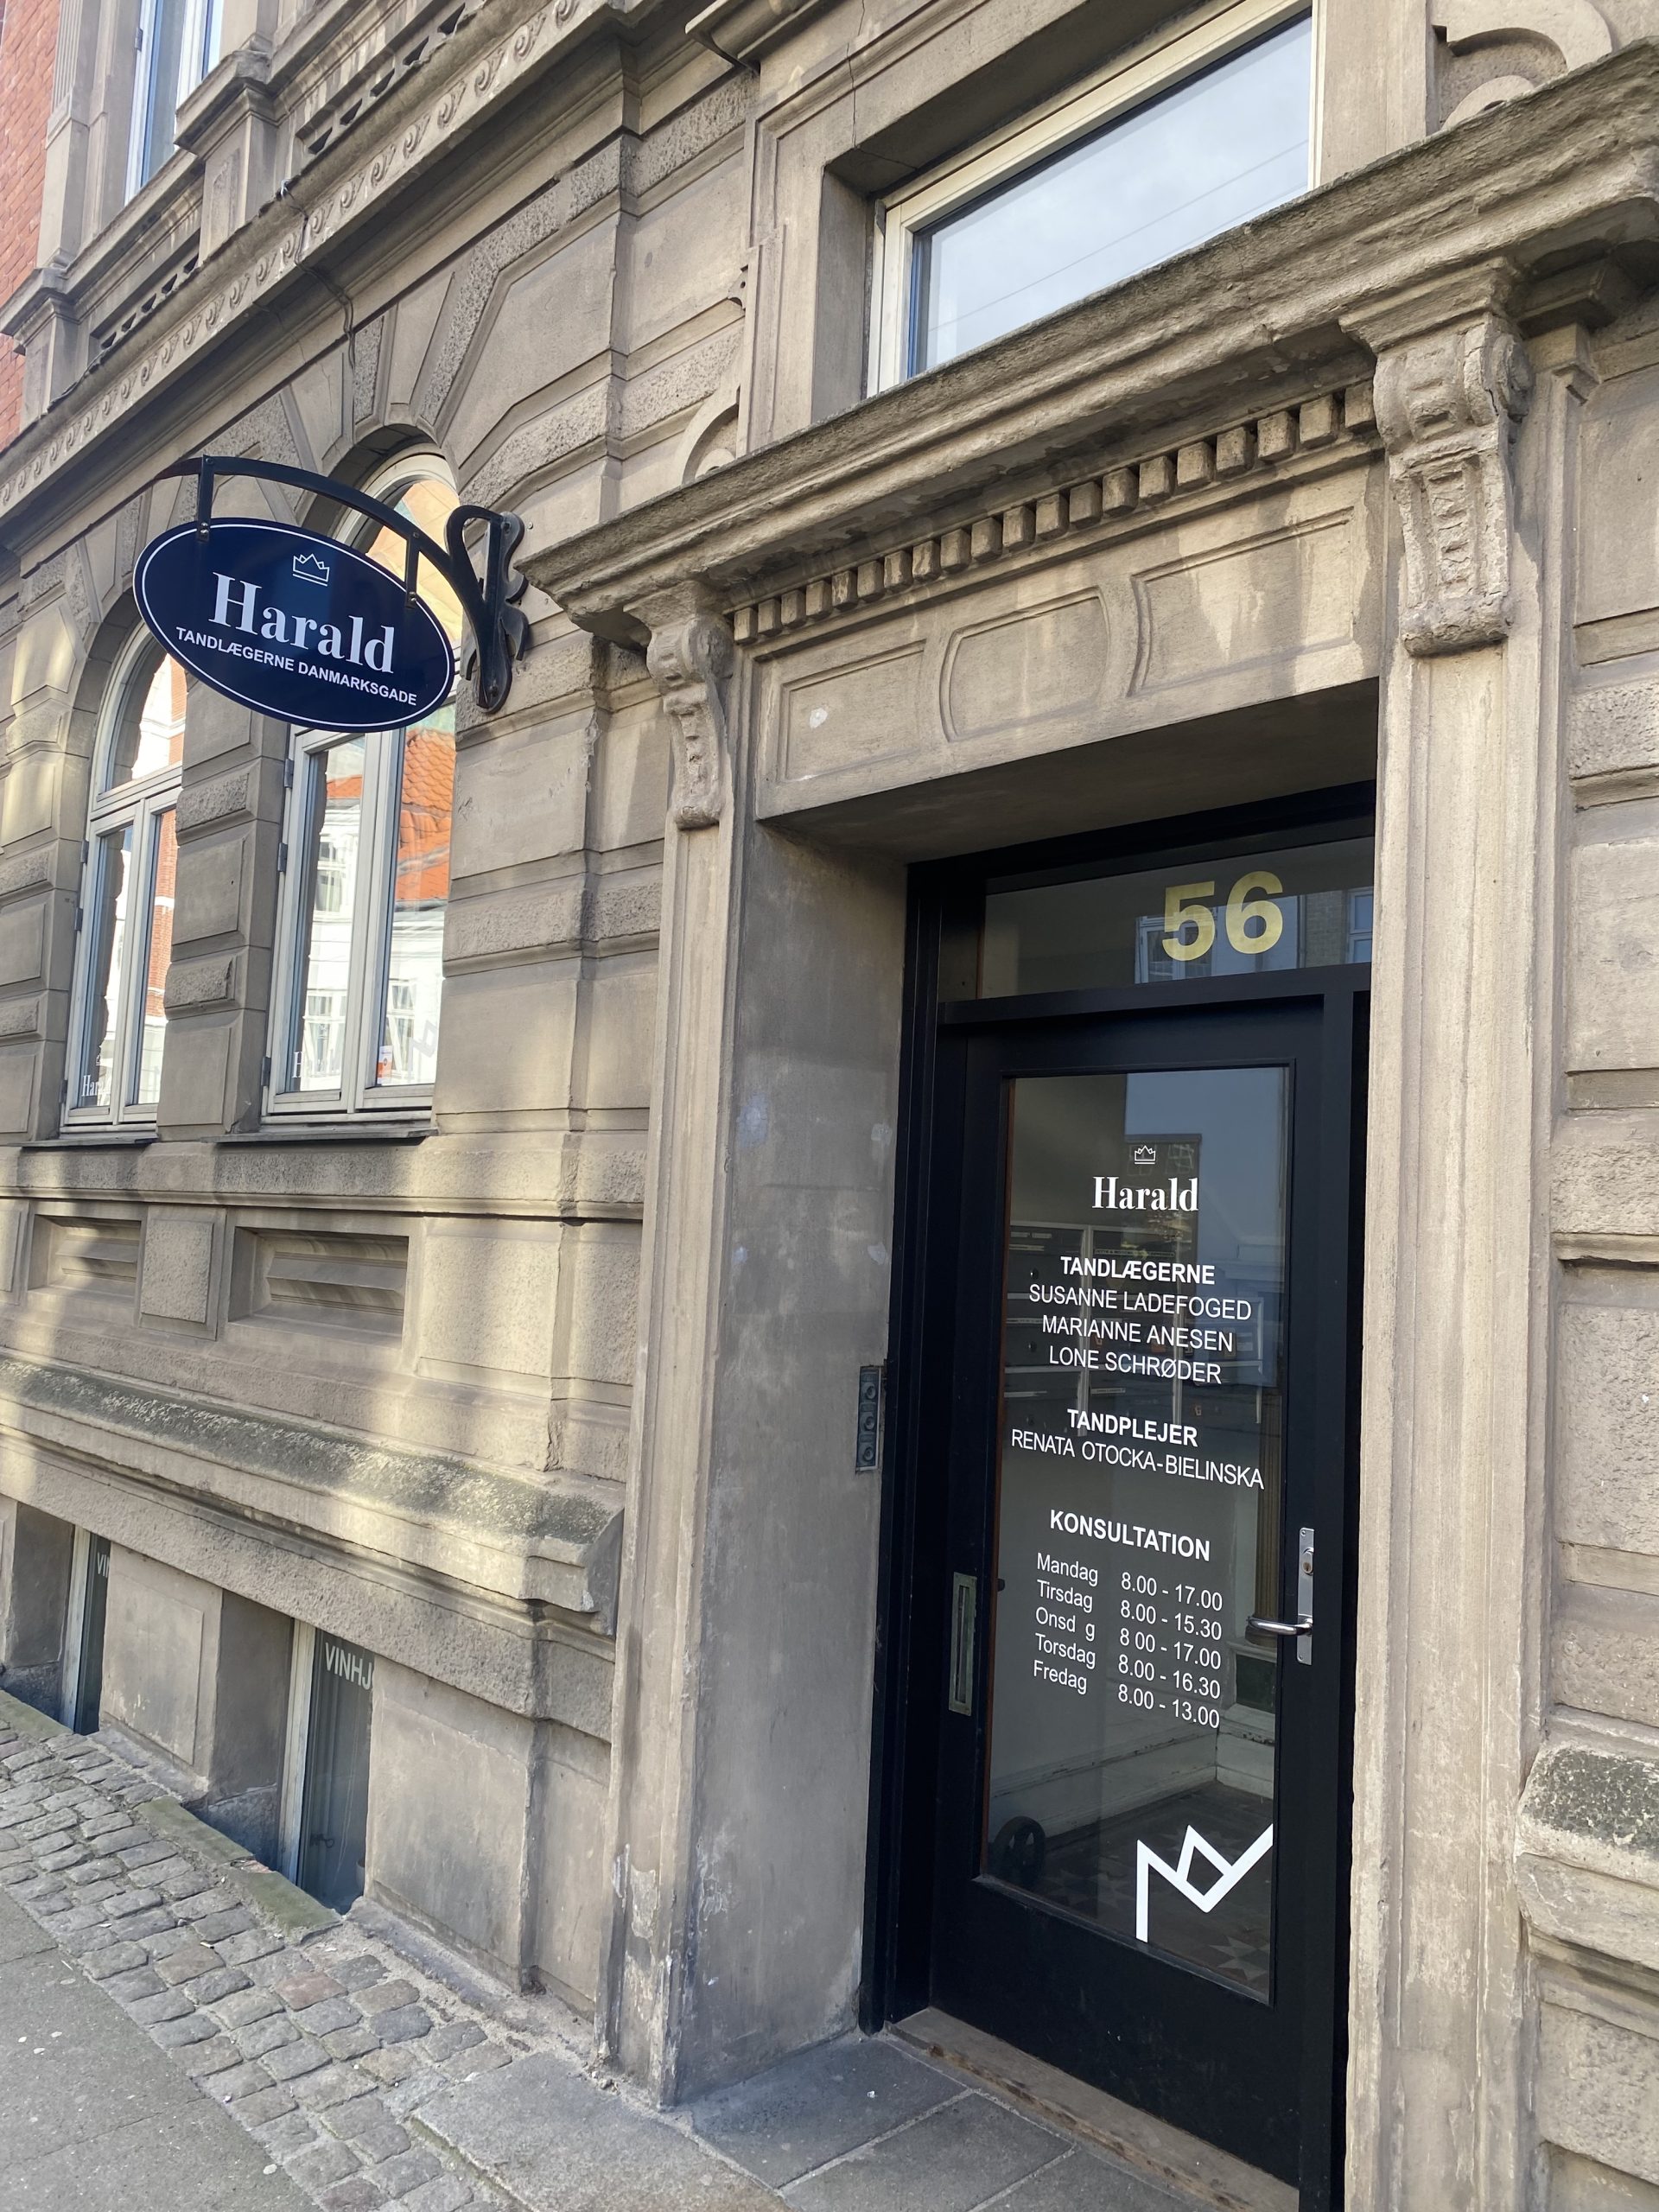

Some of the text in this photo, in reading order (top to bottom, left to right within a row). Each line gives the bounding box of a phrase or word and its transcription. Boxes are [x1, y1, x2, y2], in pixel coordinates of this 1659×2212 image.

[207, 571, 395, 674] Harald
[175, 626, 417, 706] TANDLÆGERNE DANMARKSGADE
[1161, 870, 1283, 962] 56
[1091, 1176, 1198, 1211] Harald
[1060, 1255, 1215, 1285] TANDLÆGERNE
[1029, 1283, 1252, 1320] SUSANNE LADEFOGED
[1042, 1314, 1233, 1352] MARIANNE ANESEN
[1049, 1345, 1222, 1384] LONE SCHRØDER
[1067, 1408, 1198, 1447] TANDPLEJER
[1011, 1428, 1265, 1490] RENATA OTOCKA-BIELINSKA
[1050, 1509, 1210, 1561] KONSULTATION
[1037, 1552, 1098, 1587] Mandag
[1121, 1572, 1157, 1597] 8.00
[1175, 1584, 1224, 1611] 17.00
[1037, 1579, 1093, 1613] Tirsdag
[1120, 1599, 1156, 1625] 8.00
[1174, 1612, 1223, 1641] 15.30
[325, 1642, 372, 1690] VINHJ
[1034, 1632, 1096, 1670] Torsdag
[1118, 1654, 1155, 1681] 8.00
[1173, 1669, 1221, 1700] 16.30
[1173, 1641, 1222, 1670] 17.00
[1033, 1659, 1087, 1695] Fredag
[1118, 1683, 1154, 1710] 8.00
[1172, 1699, 1220, 1729] 13.00
